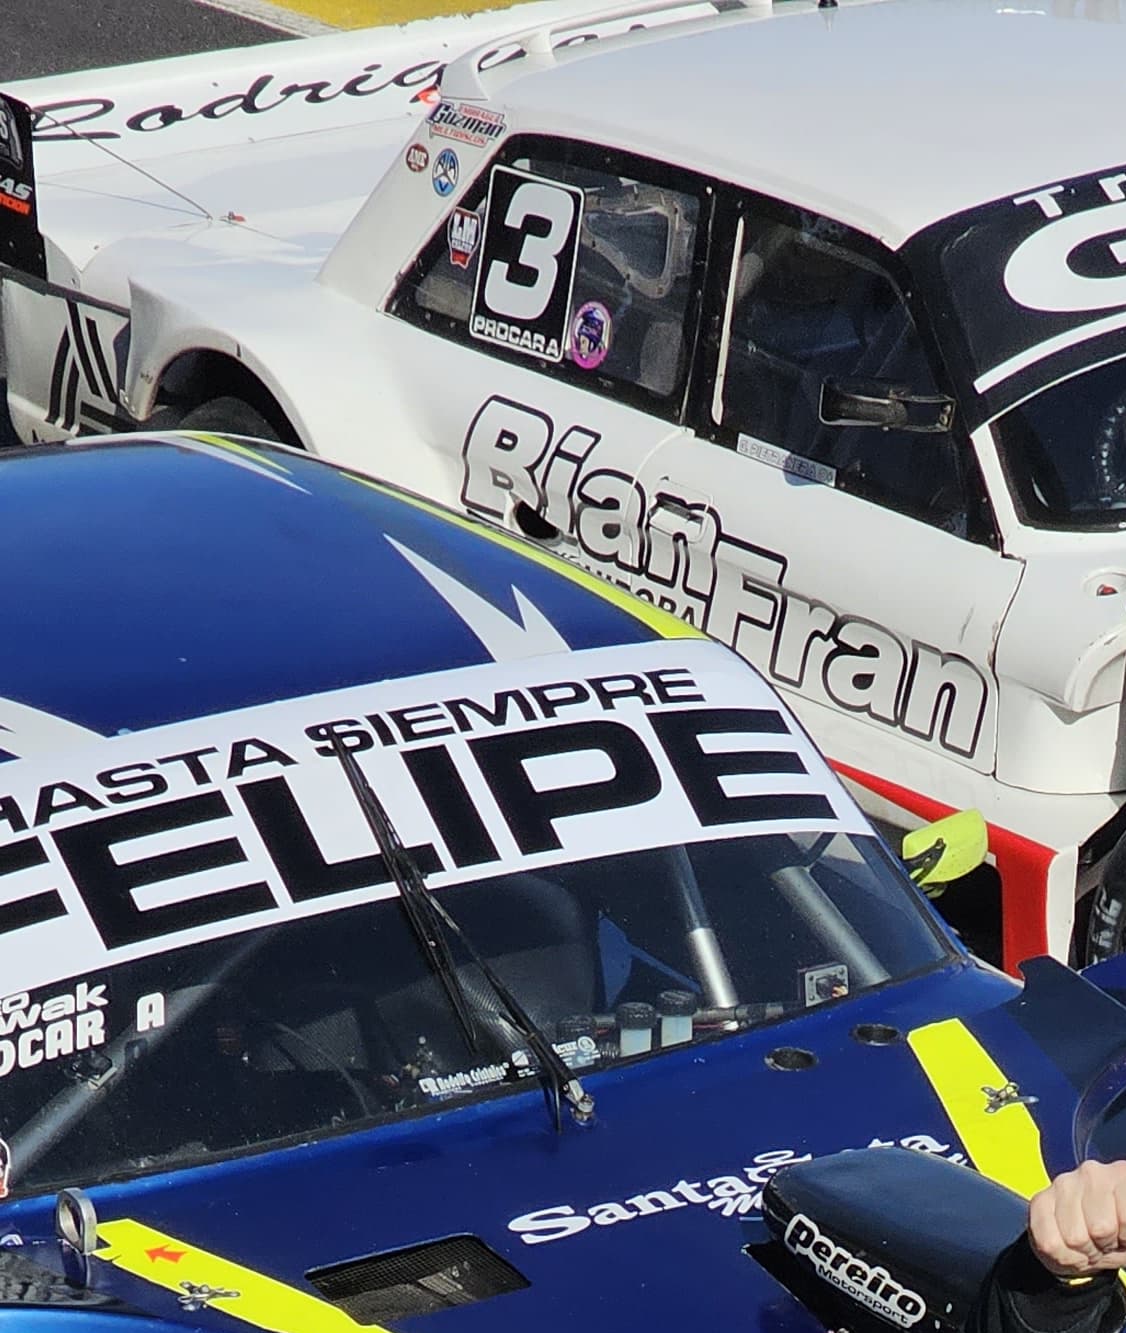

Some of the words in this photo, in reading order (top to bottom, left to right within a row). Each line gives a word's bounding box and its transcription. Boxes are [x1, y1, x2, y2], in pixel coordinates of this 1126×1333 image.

[484, 182, 575, 320] 3
[313, 667, 706, 758] SIEMPRE
[136, 991, 165, 1032] A
[508, 1173, 752, 1245] Santa
[817, 1263, 908, 1325] Motorsport
